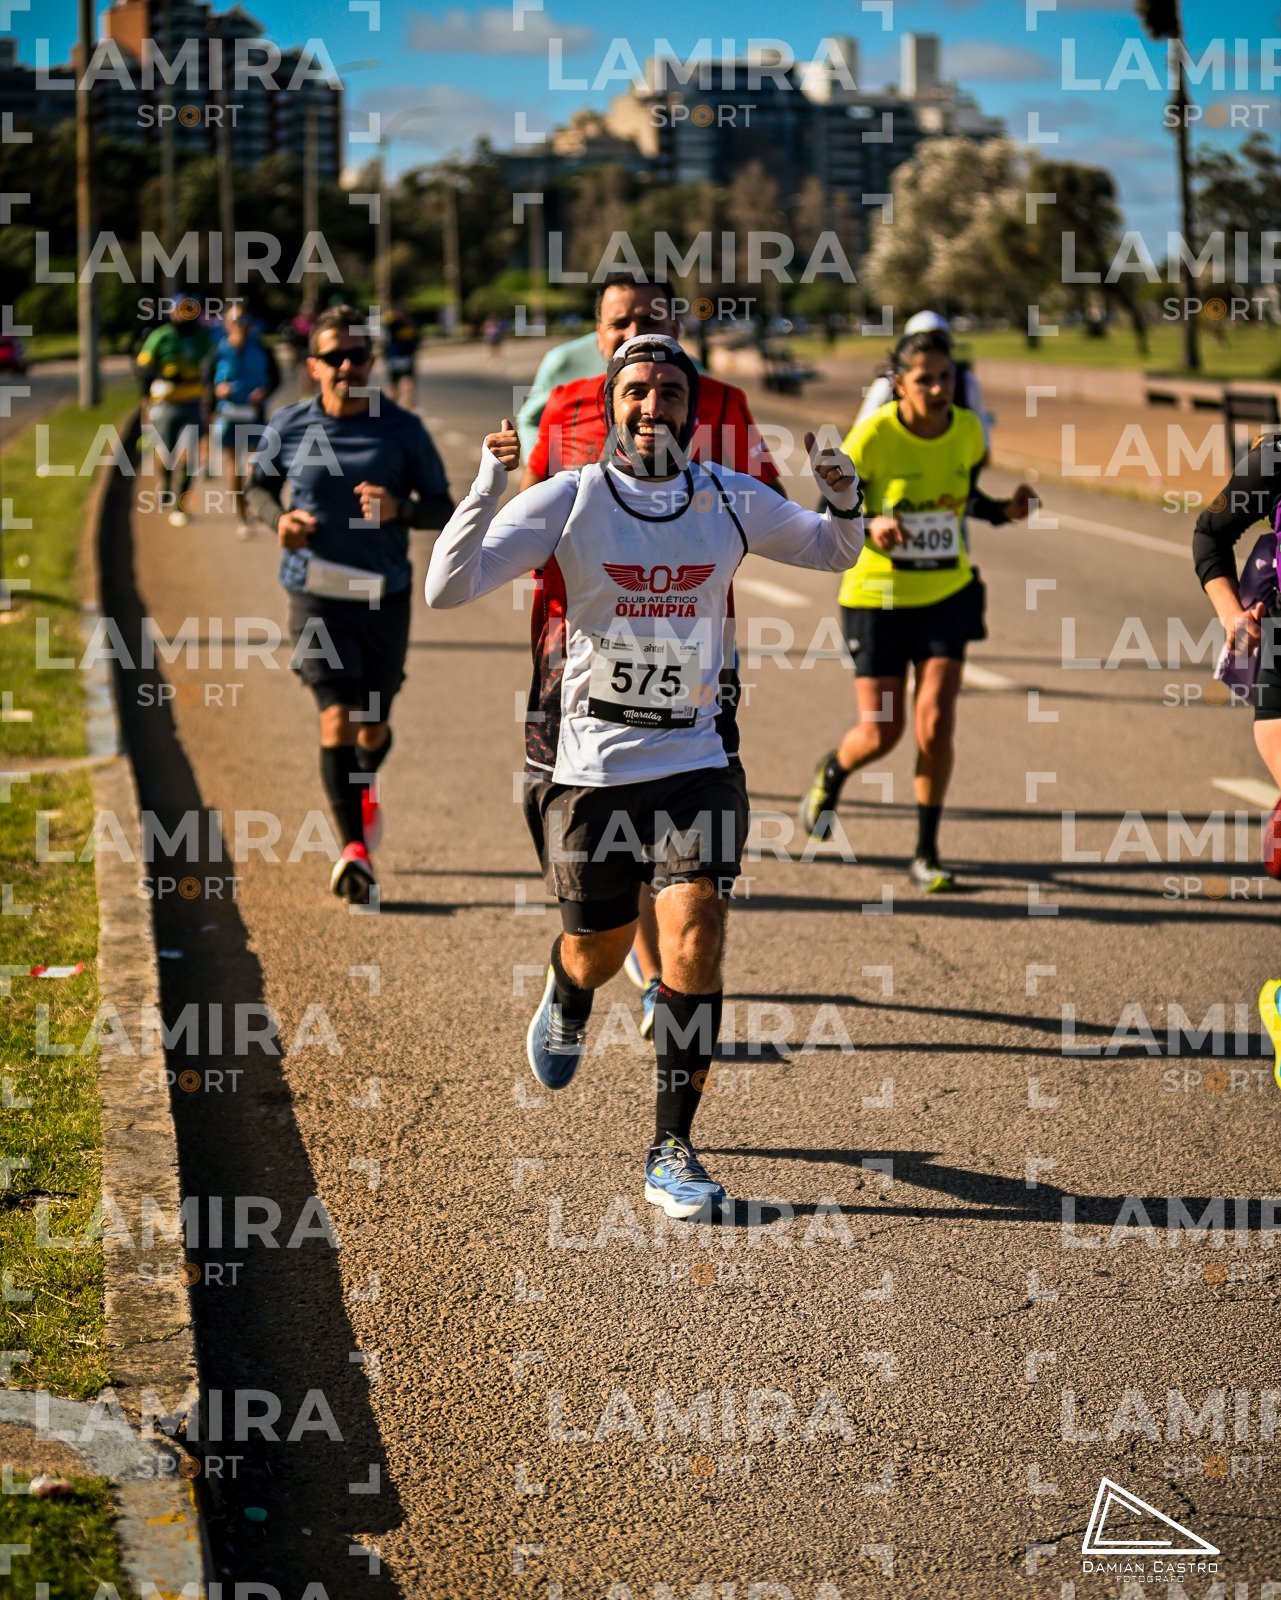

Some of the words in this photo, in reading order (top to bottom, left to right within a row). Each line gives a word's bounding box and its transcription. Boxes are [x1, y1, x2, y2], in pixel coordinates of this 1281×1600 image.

[617, 596, 645, 604] CLUB
[646, 594, 698, 604] ATLÉTICO
[615, 603, 696, 617] OLIMPIA
[610, 661, 682, 698] 575
[623, 709, 662, 722] Maratón
